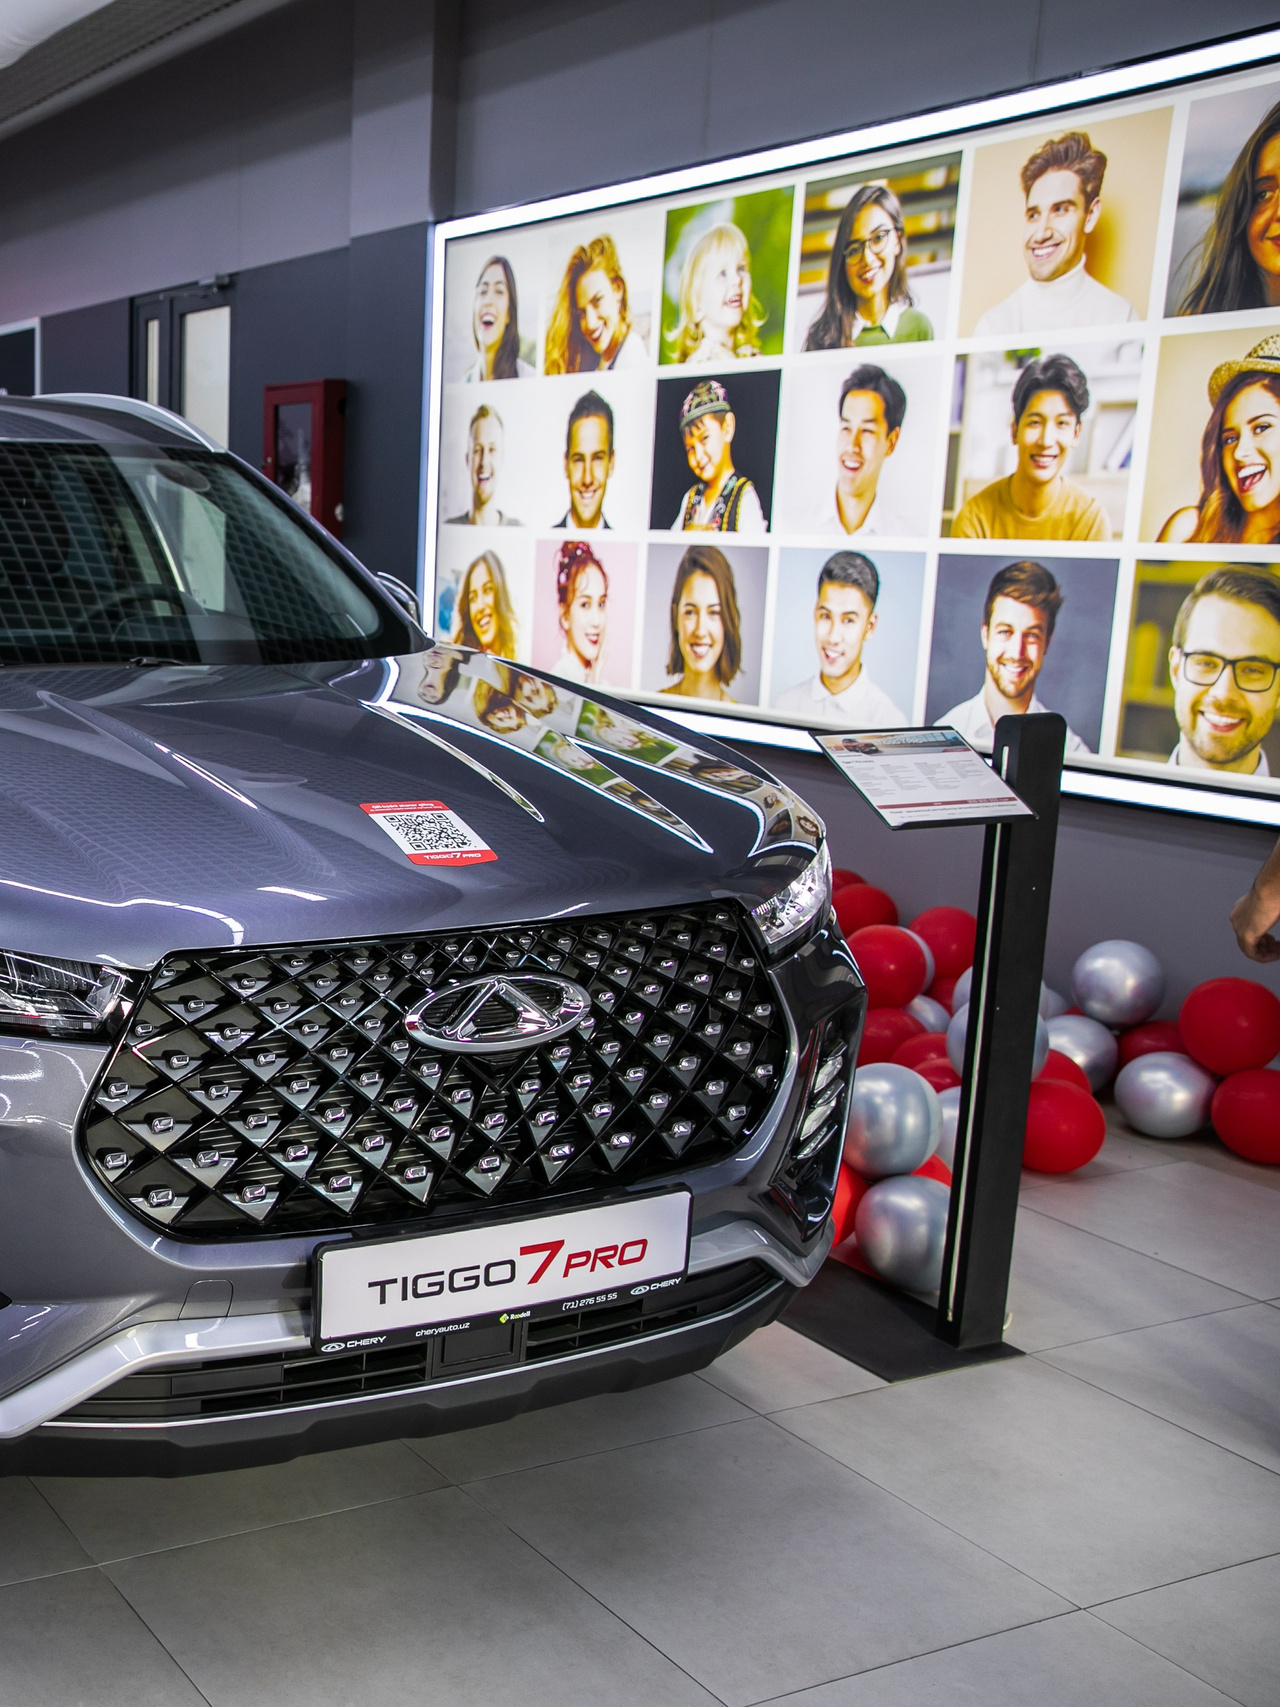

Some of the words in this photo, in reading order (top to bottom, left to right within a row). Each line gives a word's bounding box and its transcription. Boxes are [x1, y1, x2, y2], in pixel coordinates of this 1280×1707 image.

[367, 1258, 516, 1305] TIGGO
[519, 1239, 566, 1285] 7
[562, 1238, 649, 1278] PRO
[650, 1277, 682, 1291] CHERY
[562, 1300, 579, 1311] (71)
[579, 1297, 595, 1307] 276
[596, 1294, 607, 1304] 55
[607, 1291, 618, 1301] 55
[415, 1322, 471, 1337] cheryauto.uz
[346, 1335, 387, 1349] CHERY
